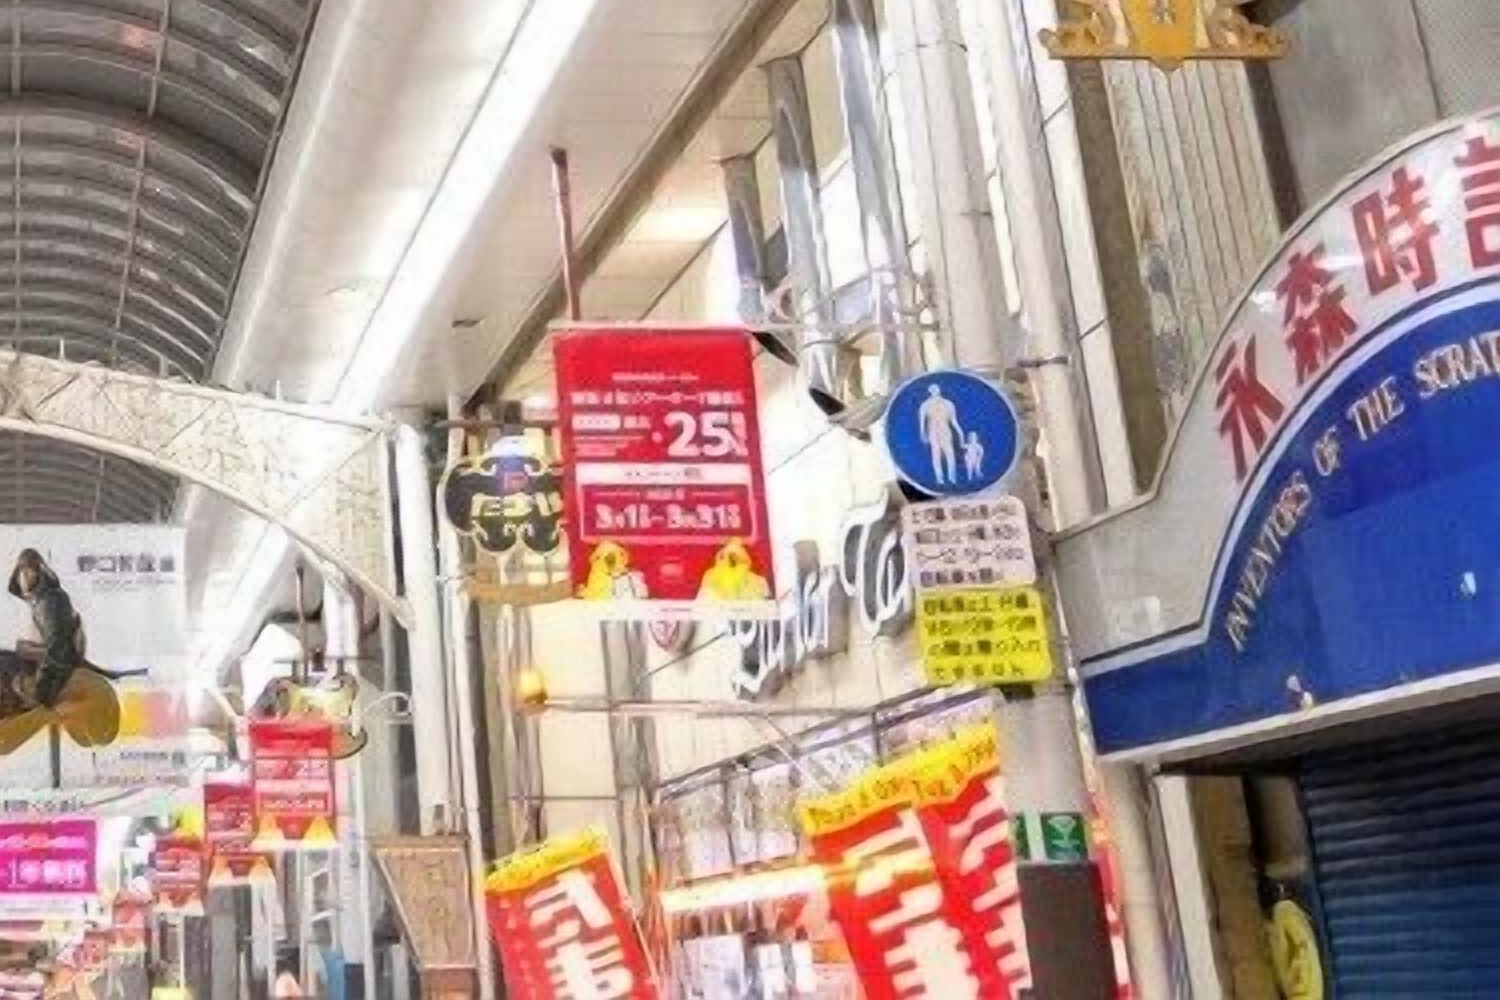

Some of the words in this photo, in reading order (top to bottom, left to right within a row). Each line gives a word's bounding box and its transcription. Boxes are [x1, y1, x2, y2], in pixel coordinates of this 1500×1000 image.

[1225, 470, 1313, 653] INVENTORS
[1312, 425, 1341, 478] OF
[1346, 375, 1406, 442] THE
